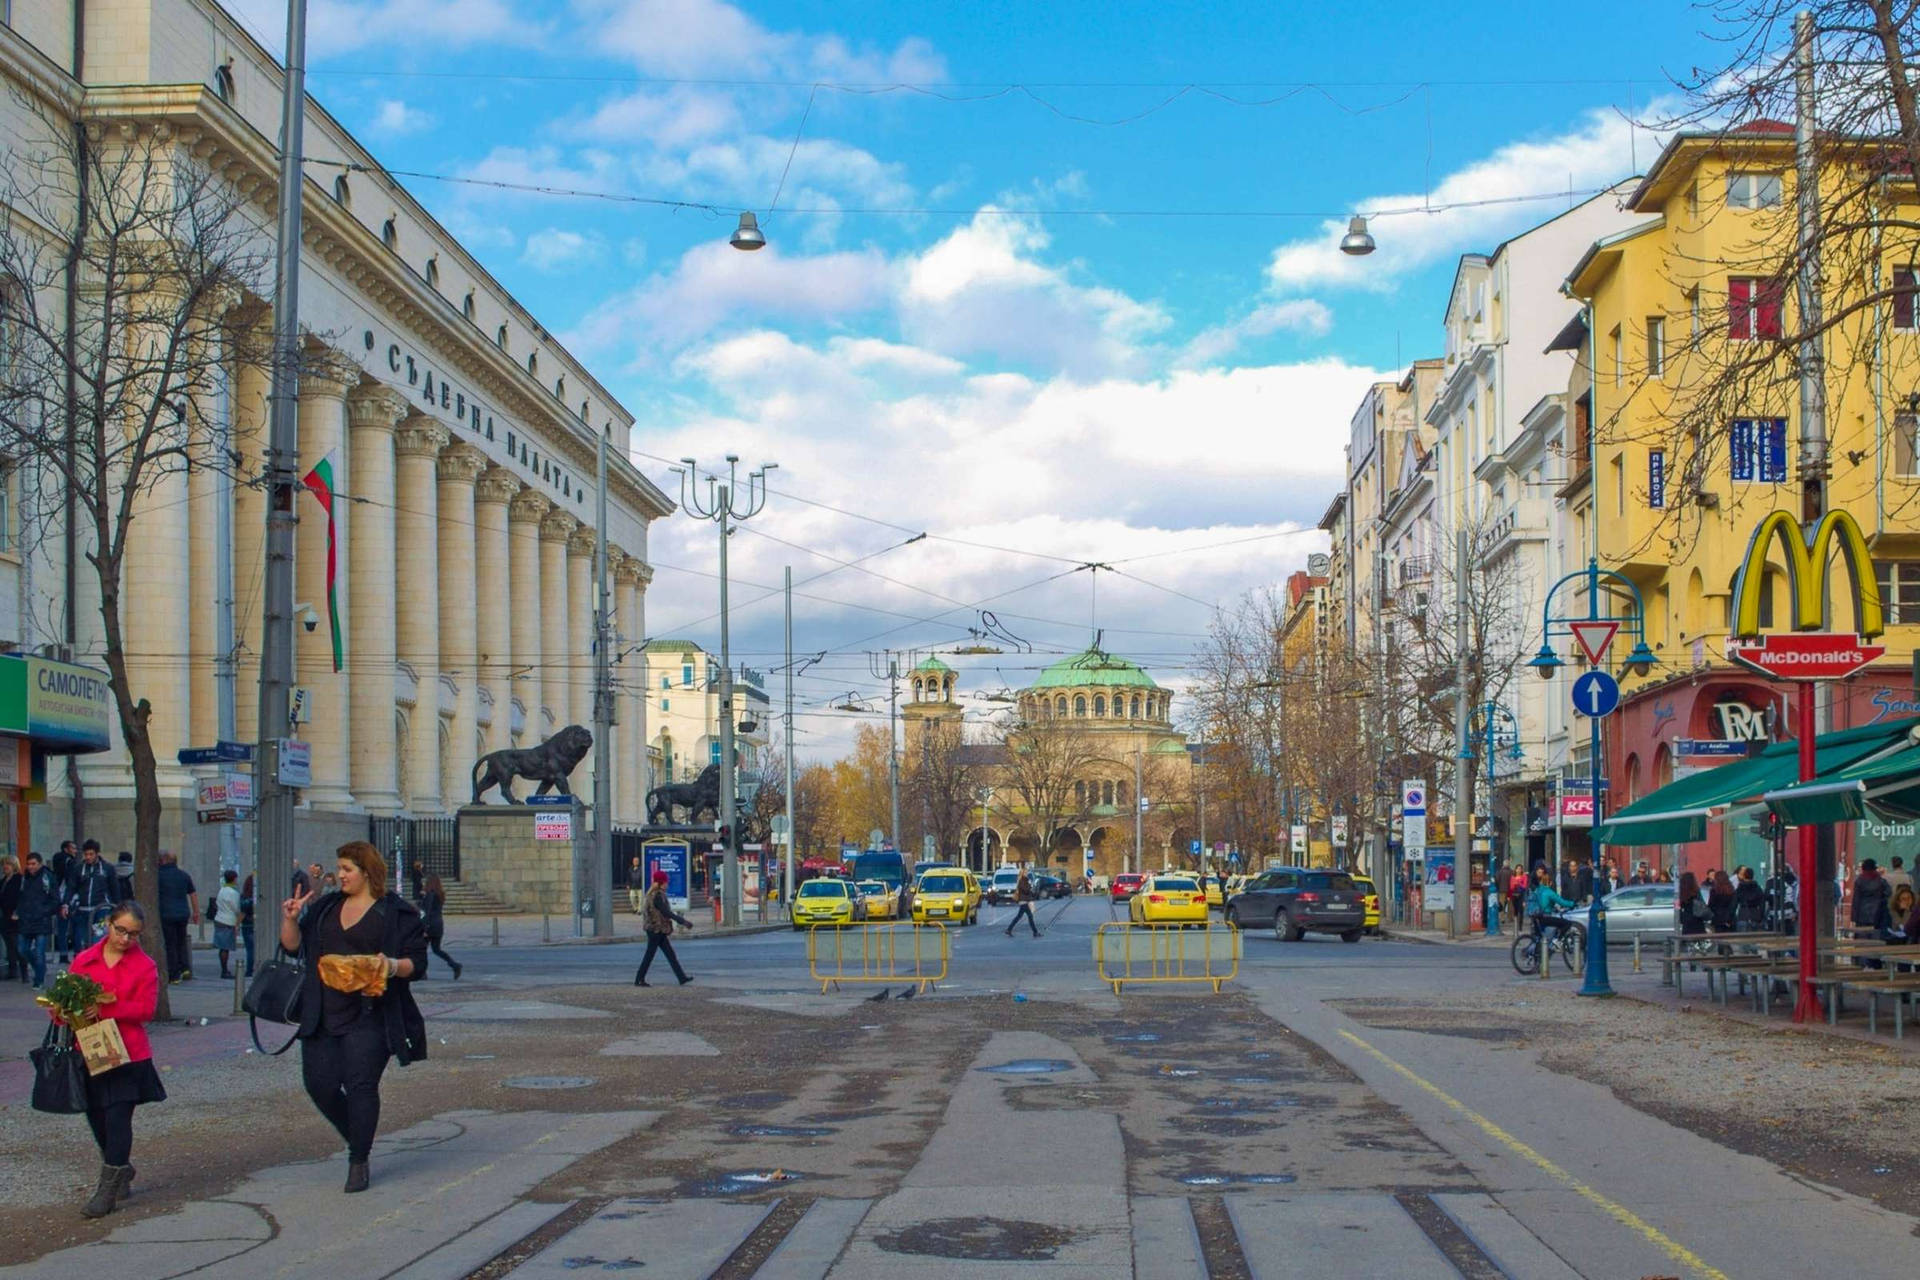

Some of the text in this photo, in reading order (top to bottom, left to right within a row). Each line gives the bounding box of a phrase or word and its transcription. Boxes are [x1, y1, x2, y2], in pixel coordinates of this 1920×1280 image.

[507, 431, 570, 497] ПАЛАТА
[1759, 651, 1864, 665] McDonald's
[1566, 801, 1593, 811] KFC
[1860, 820, 1915, 840] Pepina
